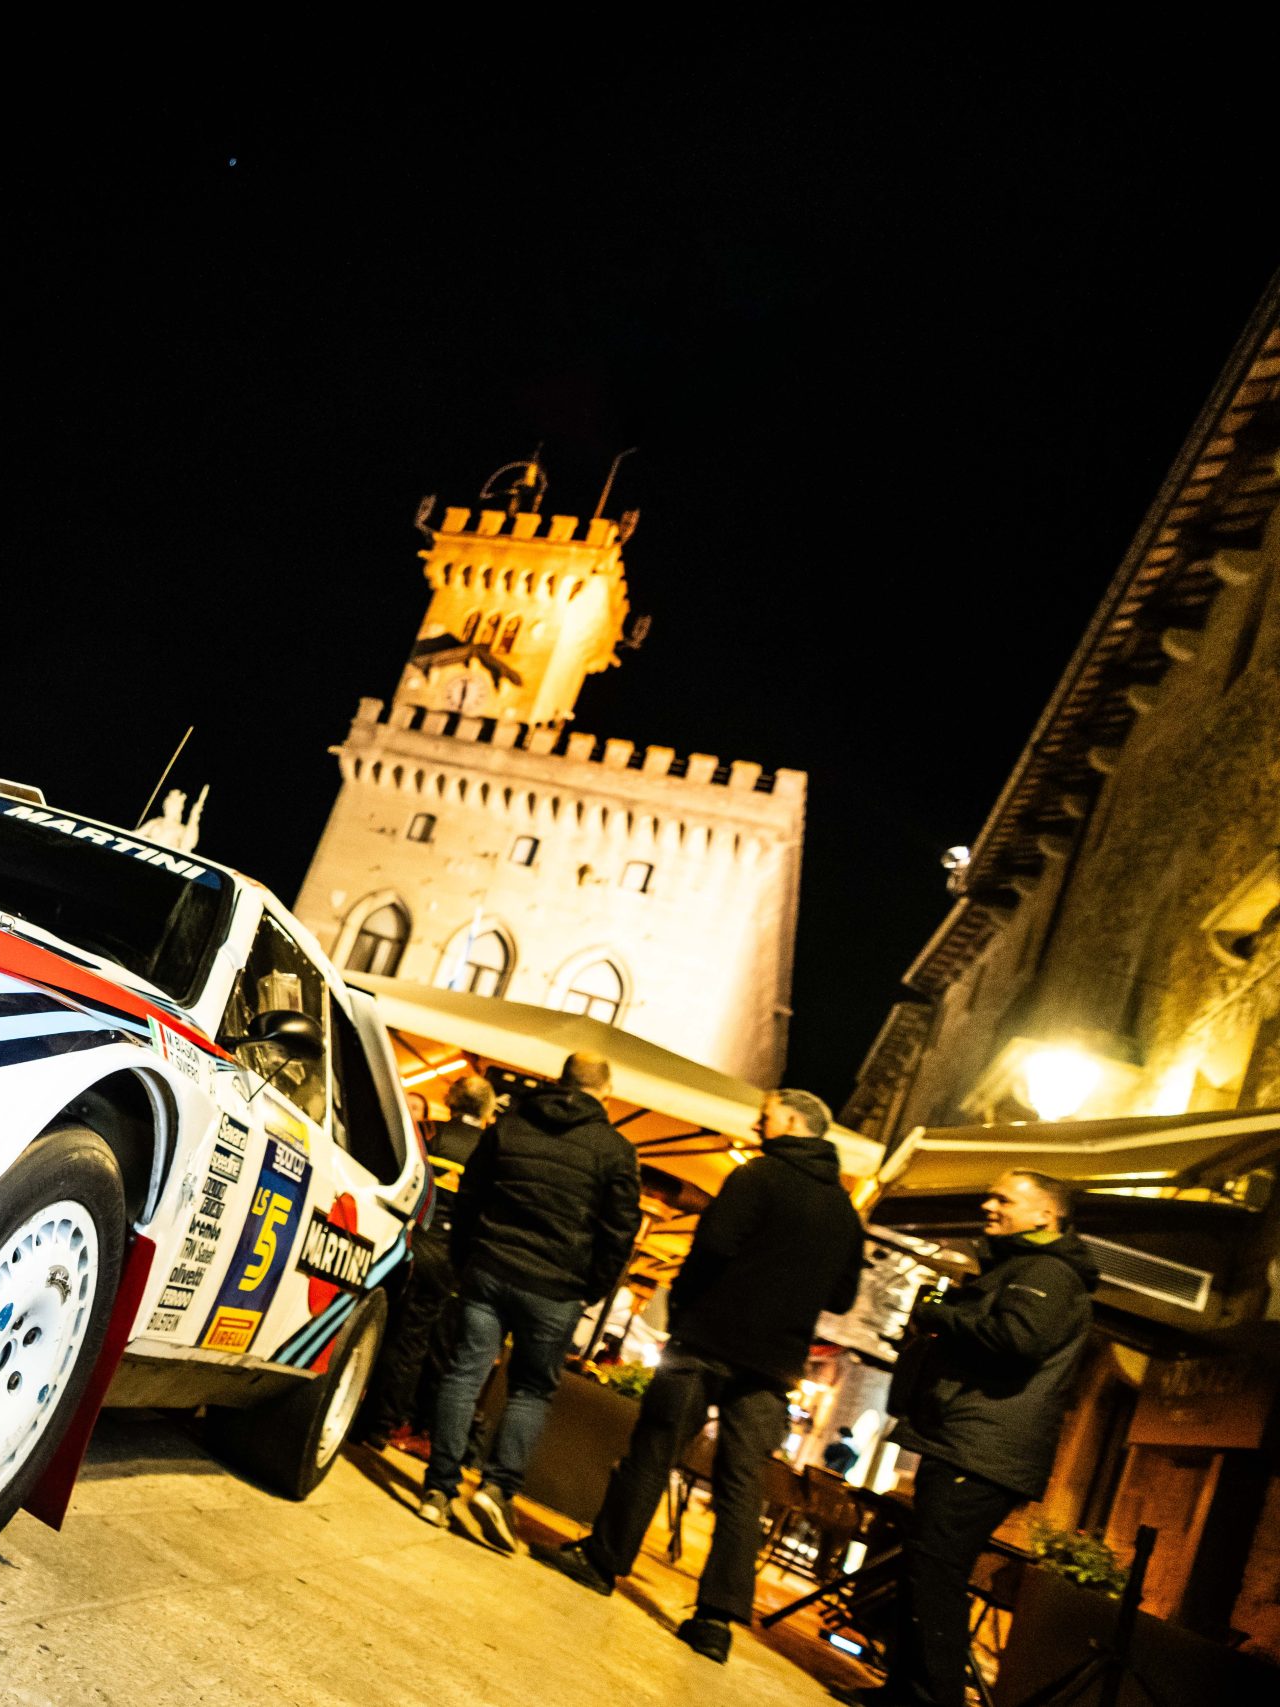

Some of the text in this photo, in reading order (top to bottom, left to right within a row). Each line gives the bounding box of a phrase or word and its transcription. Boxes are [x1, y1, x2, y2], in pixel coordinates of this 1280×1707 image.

[4, 806, 206, 880] MARTINI
[238, 1192, 293, 1292] 5
[301, 1221, 372, 1286] MARTINI
[169, 1263, 207, 1287] olivetti
[208, 1316, 254, 1347] PIRELLI
